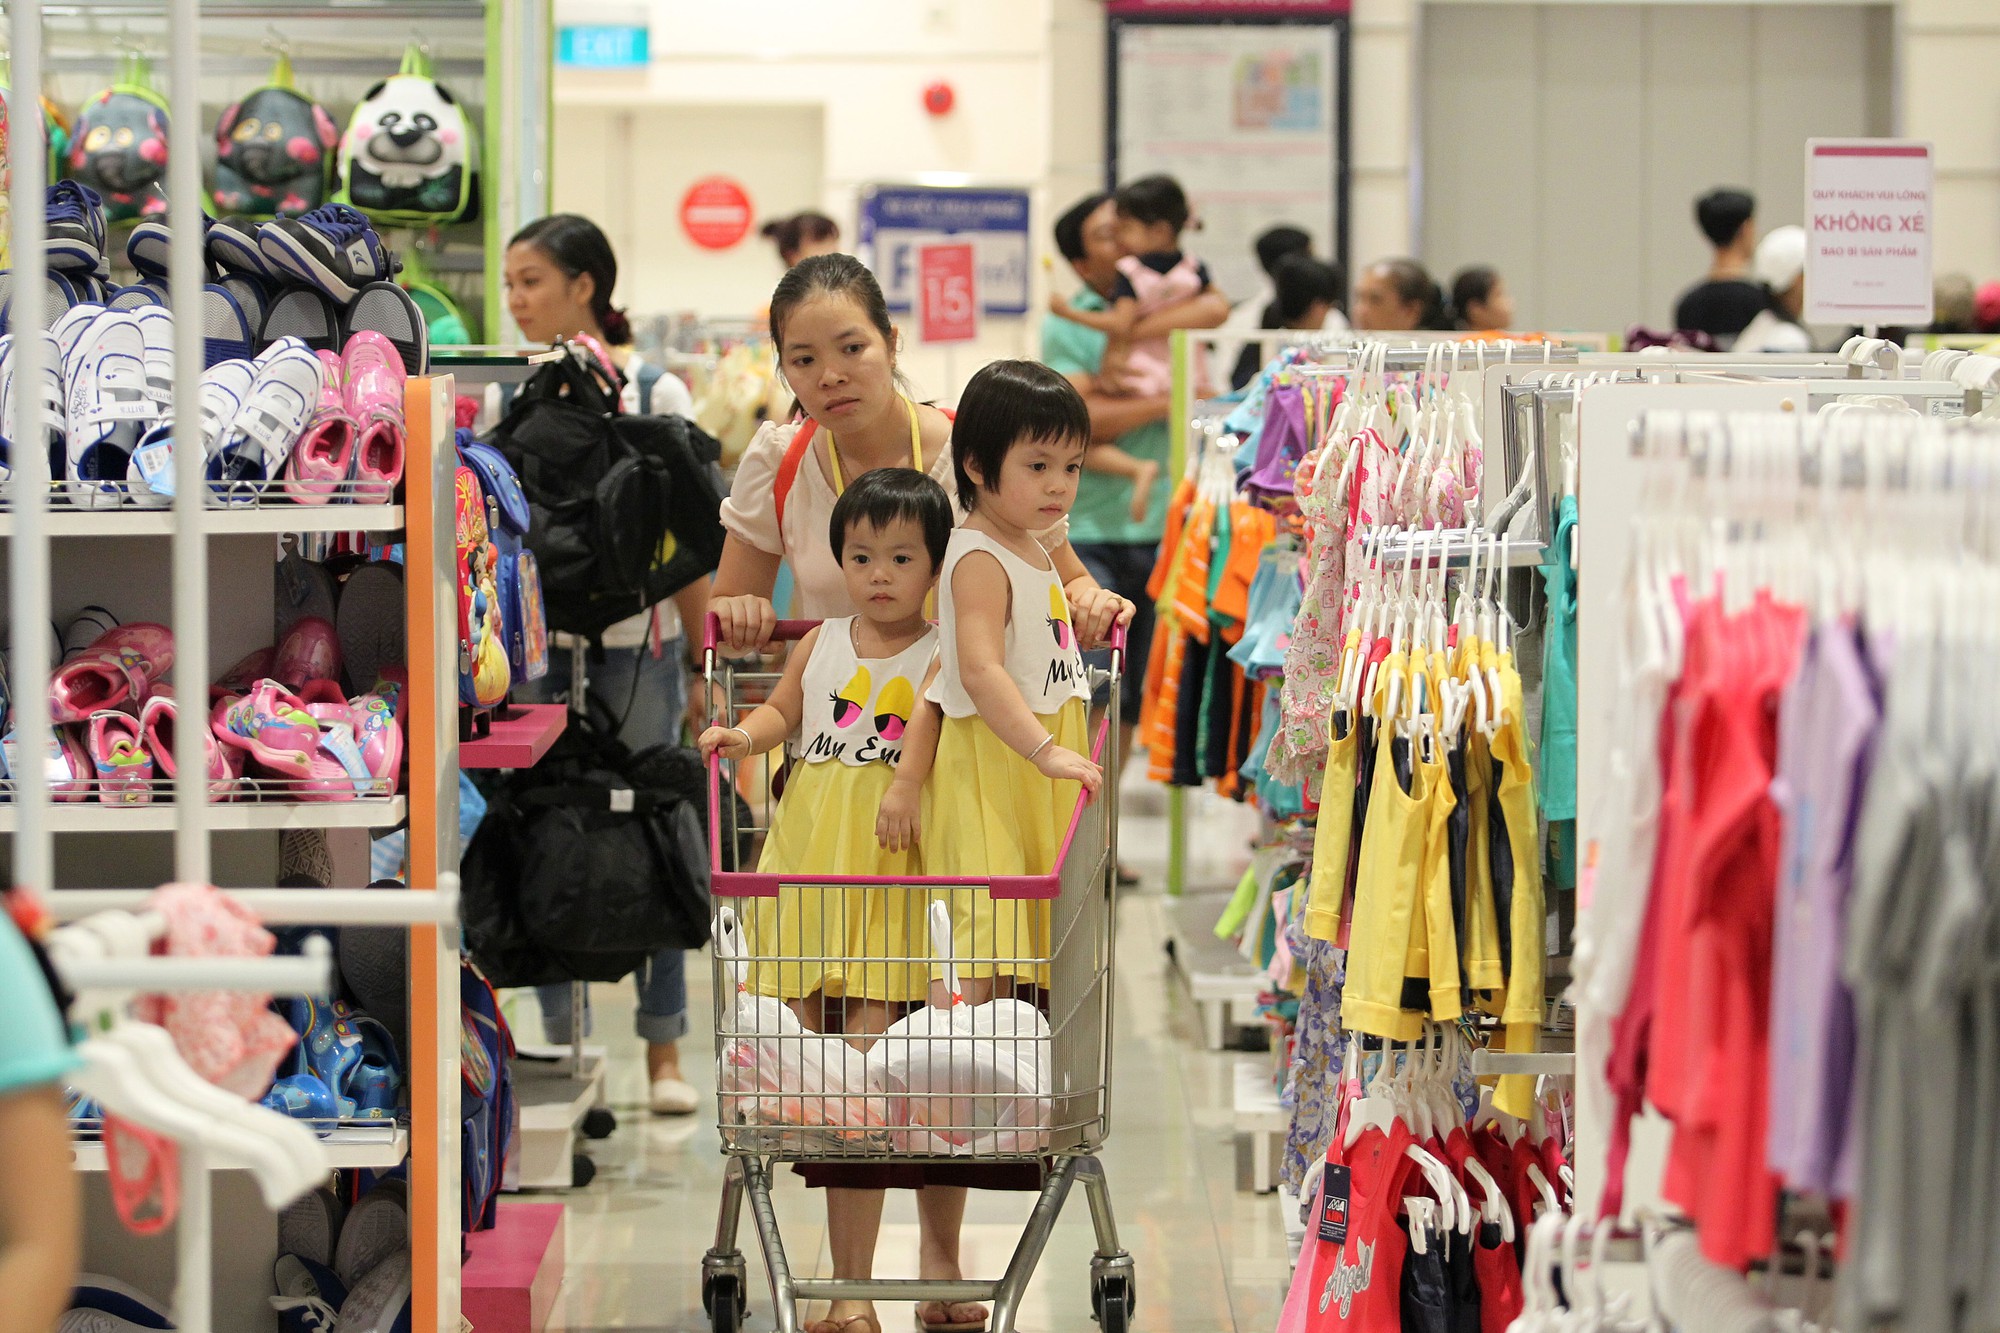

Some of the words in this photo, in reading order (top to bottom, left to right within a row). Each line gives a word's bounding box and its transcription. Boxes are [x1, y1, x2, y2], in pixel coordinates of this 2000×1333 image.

[1876, 190, 1894, 200] VUI
[1813, 209, 1892, 232] KHÔNG
[1898, 209, 1925, 233] XÉ
[1821, 247, 1843, 256] BAO
[926, 275, 973, 322] 15
[1043, 658, 1076, 697] My
[803, 731, 847, 761] My
[1319, 1245, 1372, 1320] Angel
